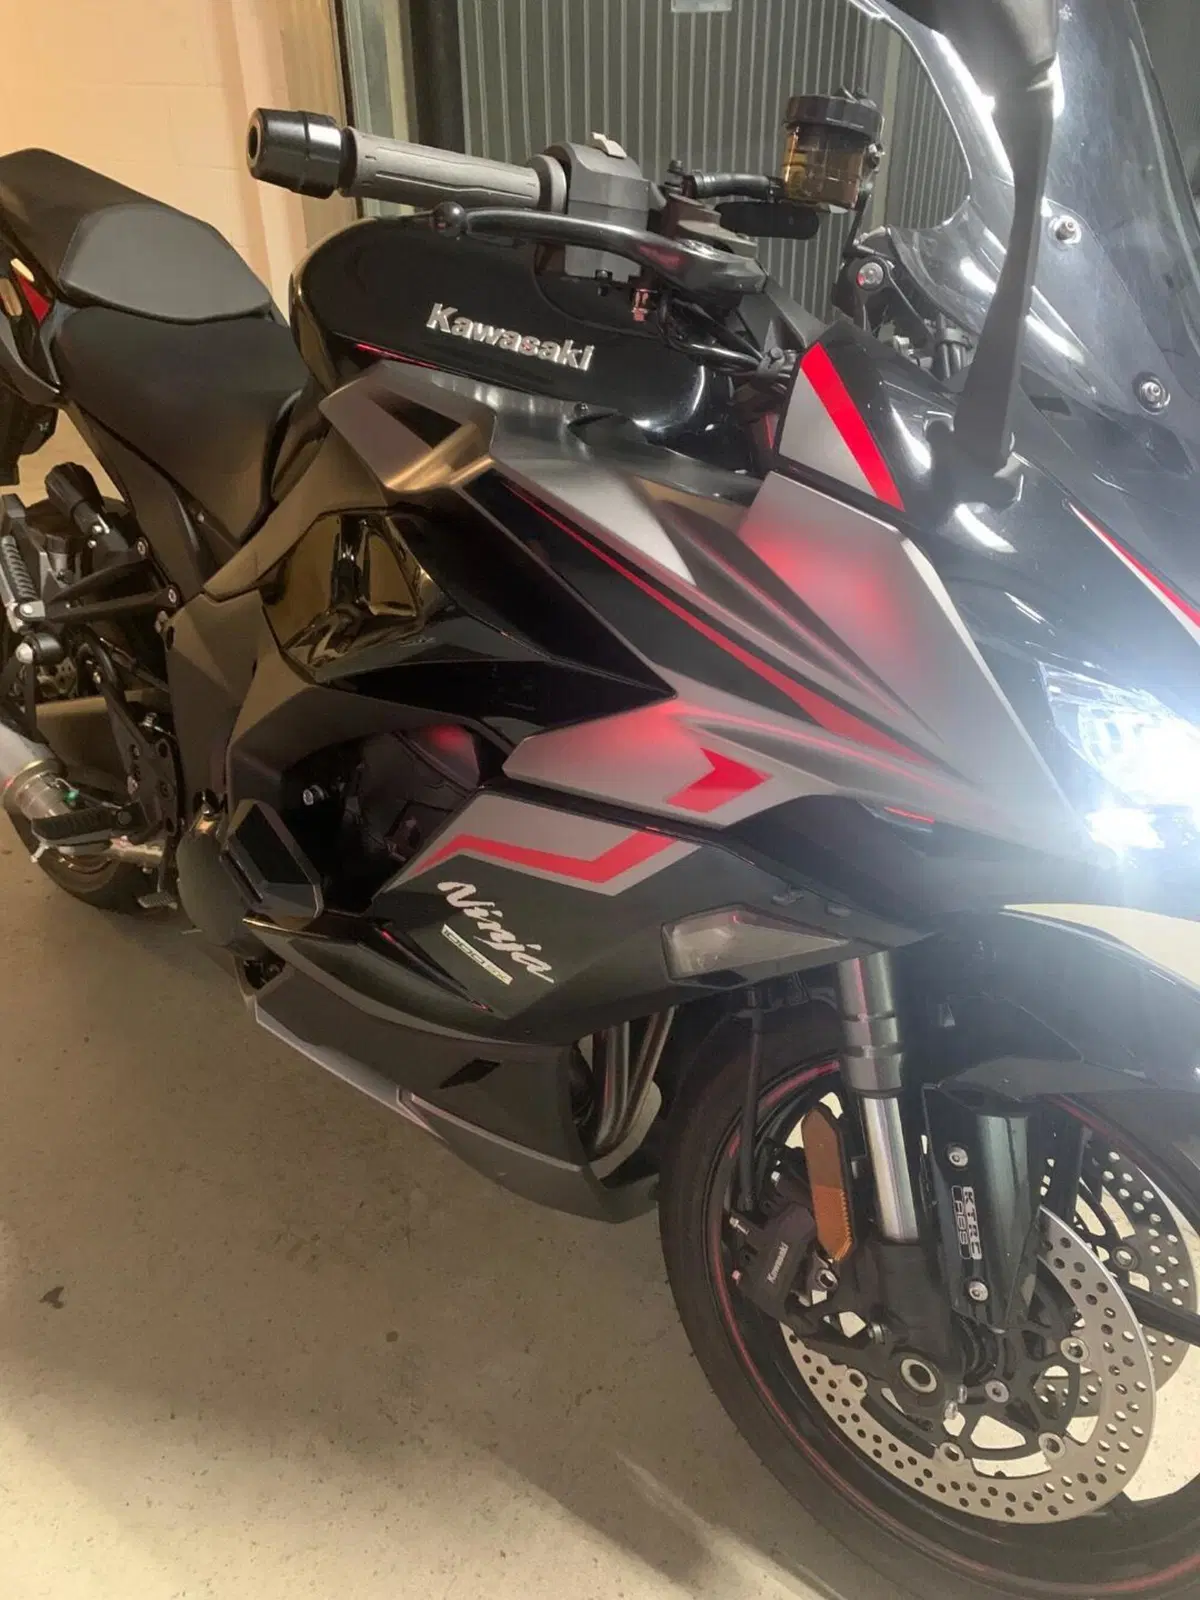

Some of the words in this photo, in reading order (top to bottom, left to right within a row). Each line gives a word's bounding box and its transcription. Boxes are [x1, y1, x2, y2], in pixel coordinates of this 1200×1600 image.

[426, 302, 595, 371] Kawasaki
[437, 881, 555, 984] Ninja
[443, 927, 510, 983] 1000
[963, 1188, 982, 1257] KTRC
